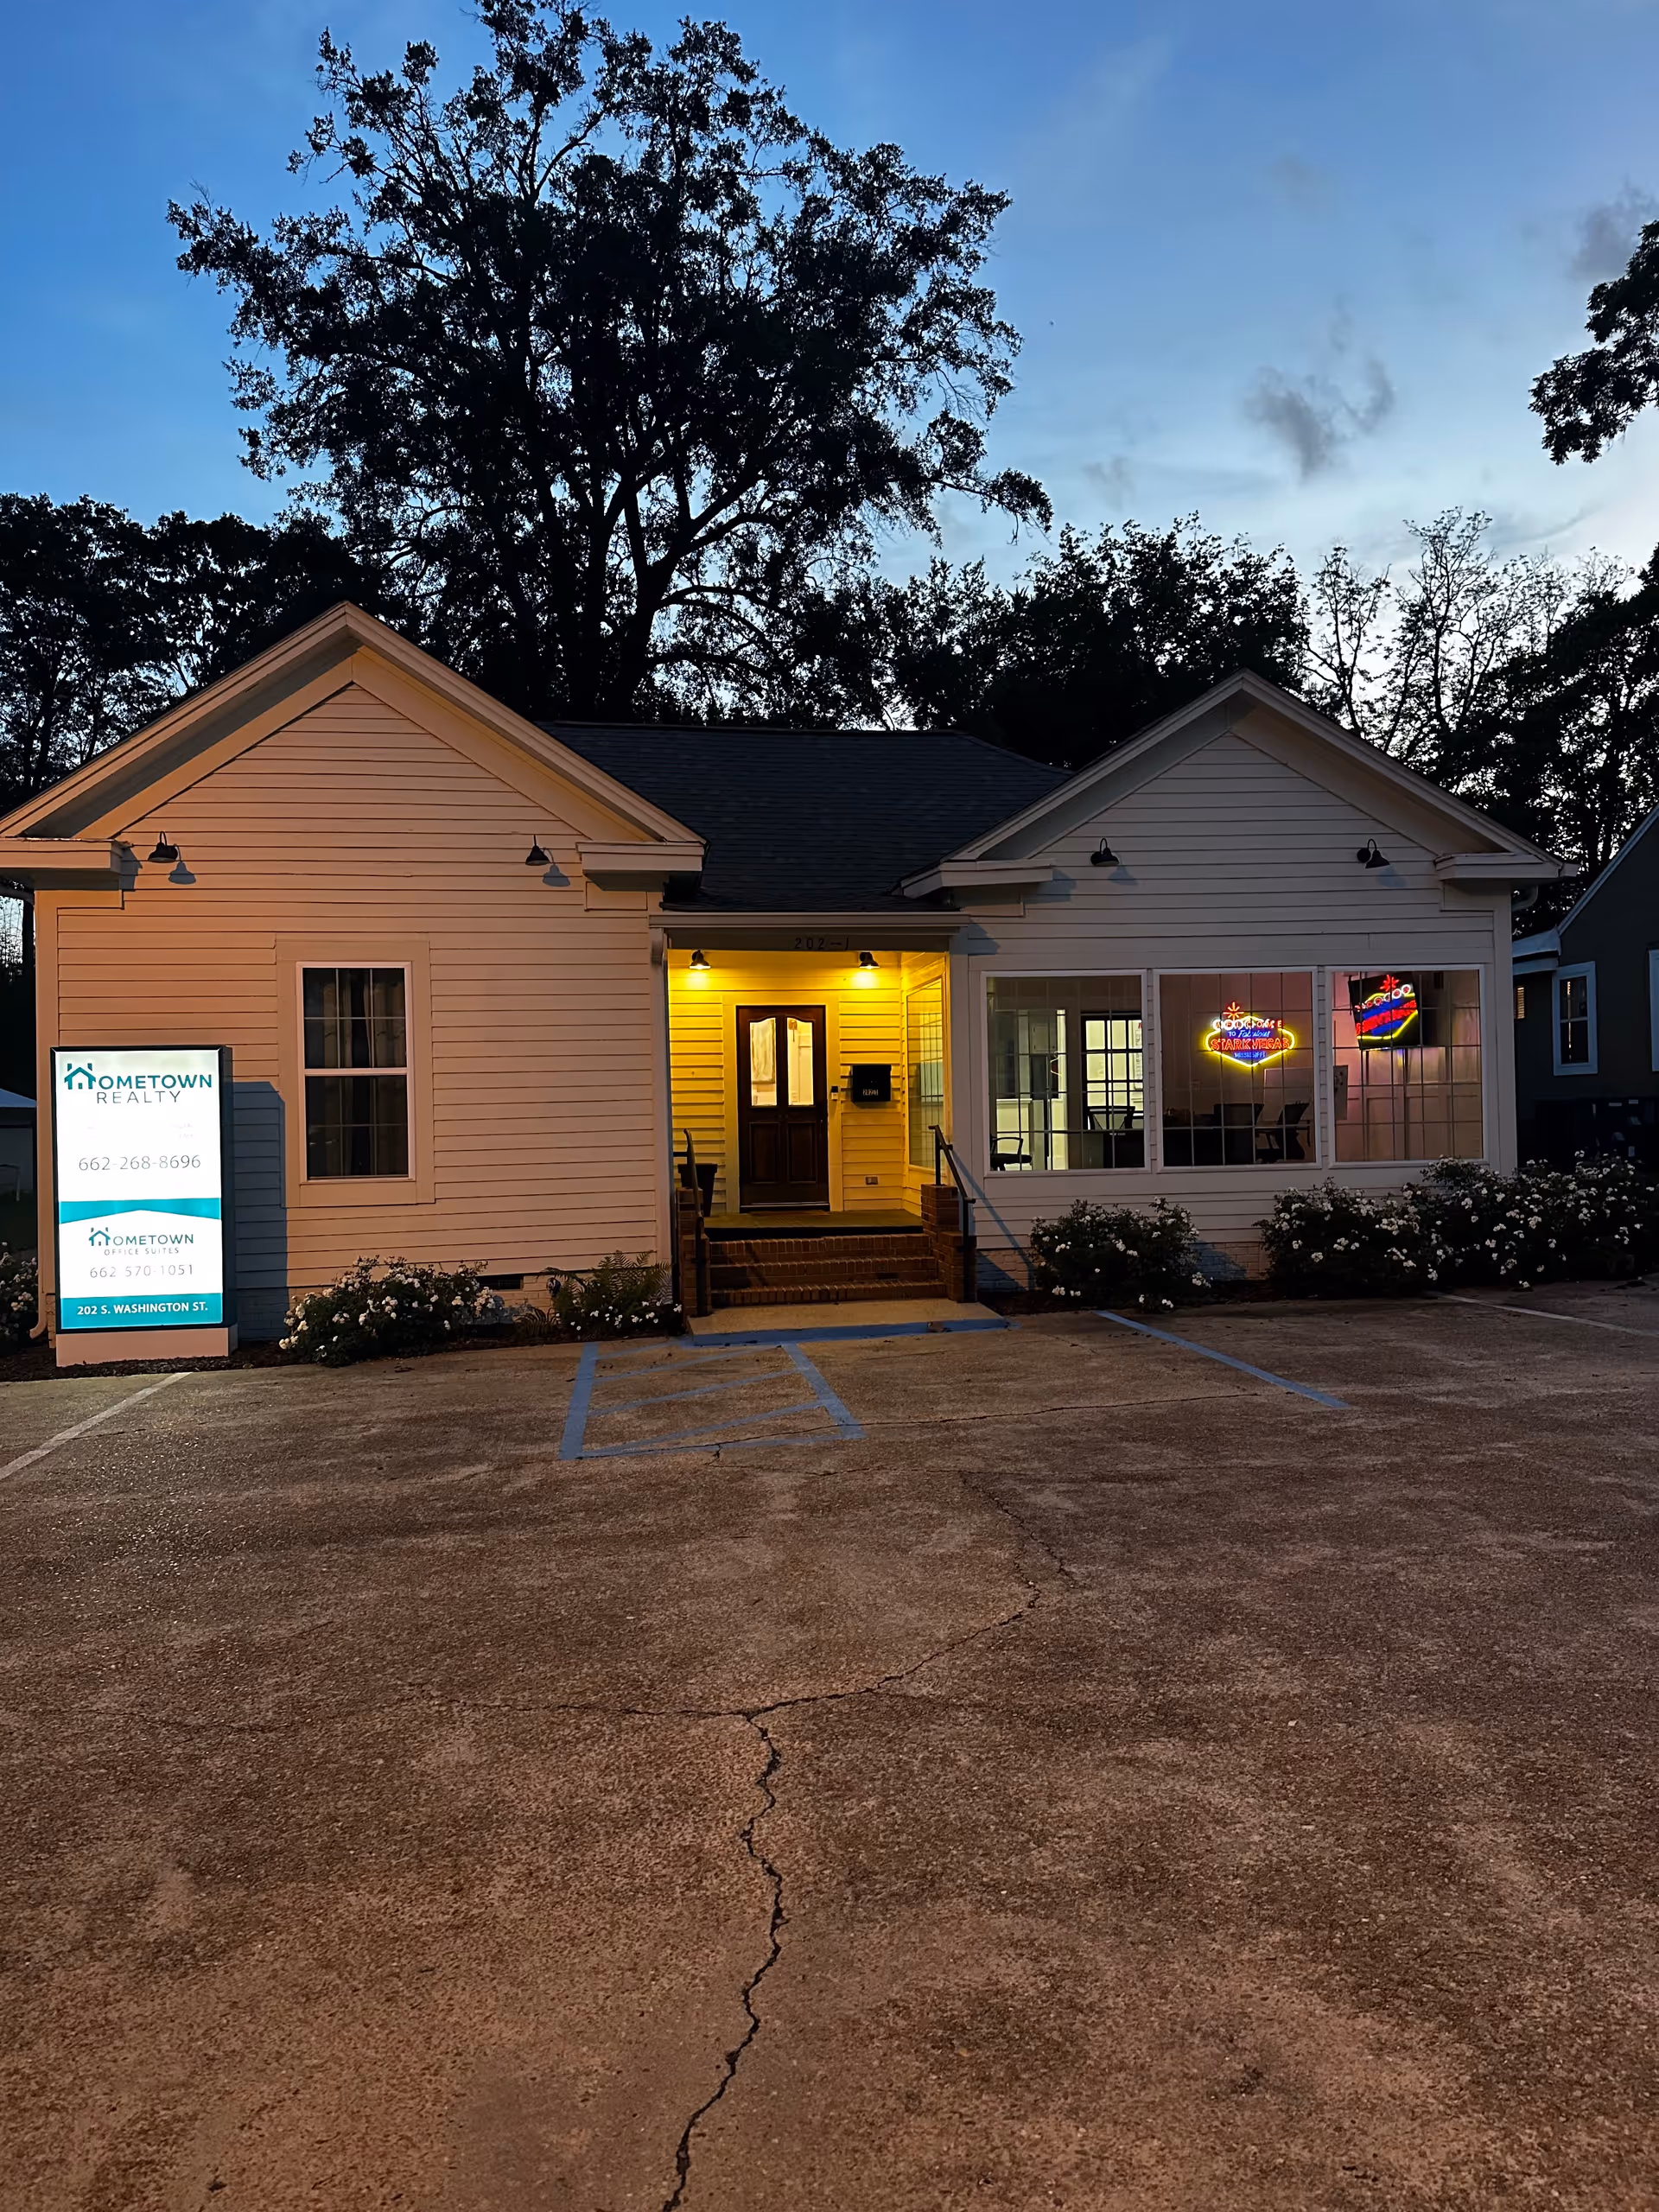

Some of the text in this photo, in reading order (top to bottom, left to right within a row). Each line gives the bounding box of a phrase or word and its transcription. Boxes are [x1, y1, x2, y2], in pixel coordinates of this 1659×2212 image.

[96, 1090, 181, 1104] REALTY
[79, 1154, 200, 1171] 662-268-8696
[77, 1301, 208, 1315] 202 S. WASHINGTON ST.
